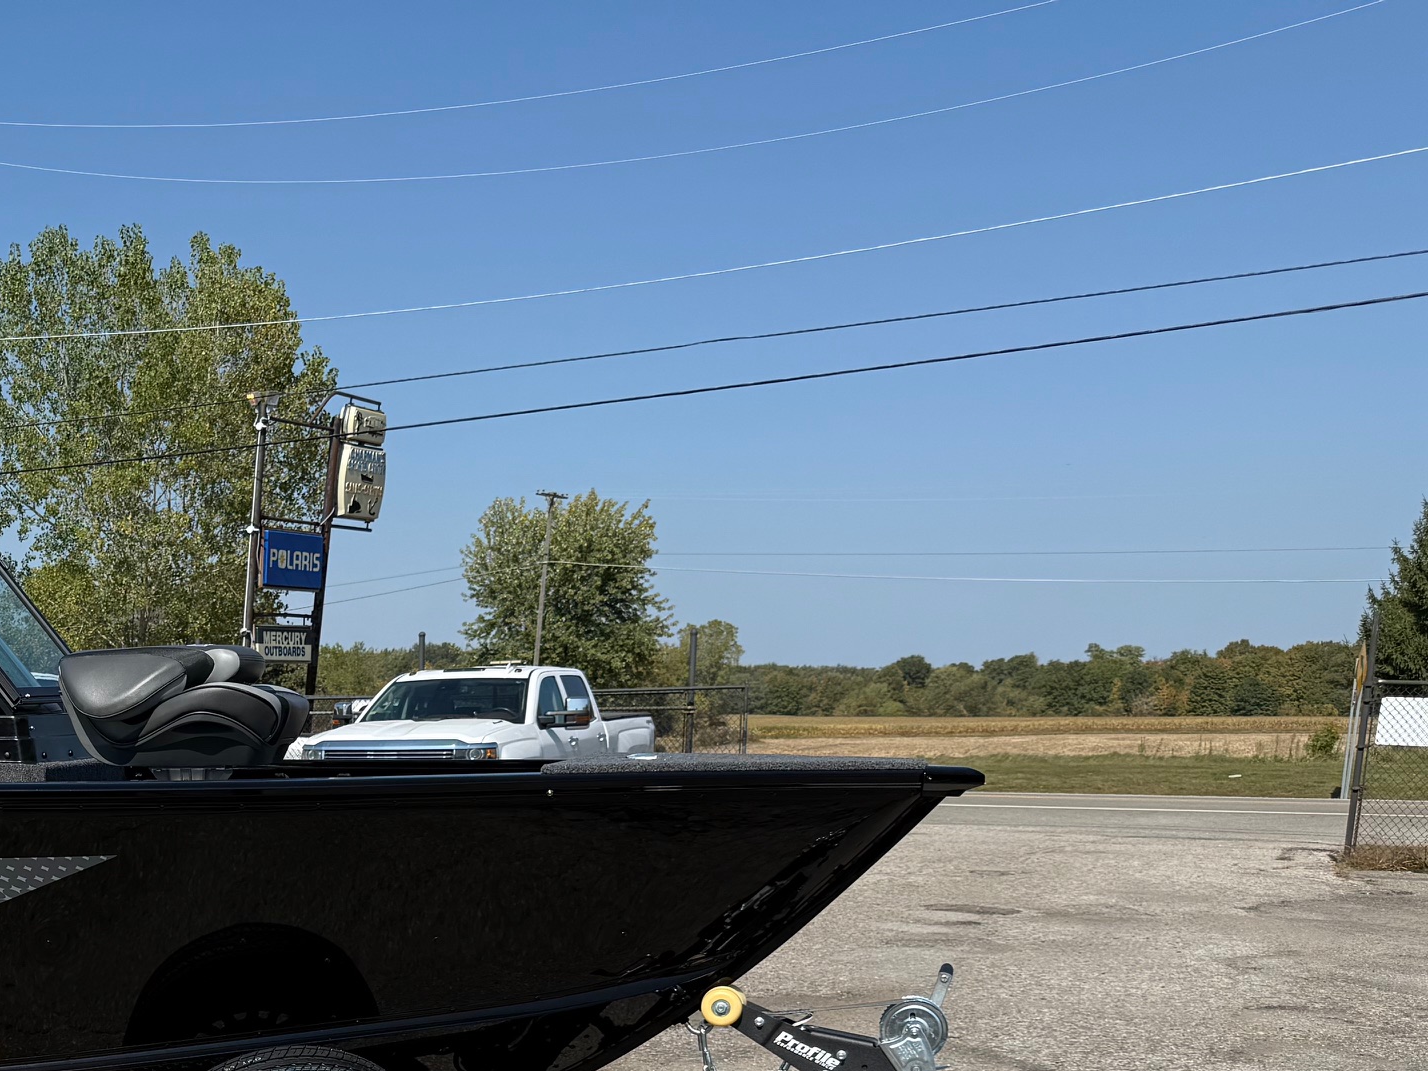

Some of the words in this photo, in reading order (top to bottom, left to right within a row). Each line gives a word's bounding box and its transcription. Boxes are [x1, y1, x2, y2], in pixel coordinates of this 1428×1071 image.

[269, 548, 321, 572] POLARIS
[262, 631, 307, 646] MERCURY
[264, 645, 306, 657] OUTBOARDS
[774, 1030, 841, 1067] Profile
